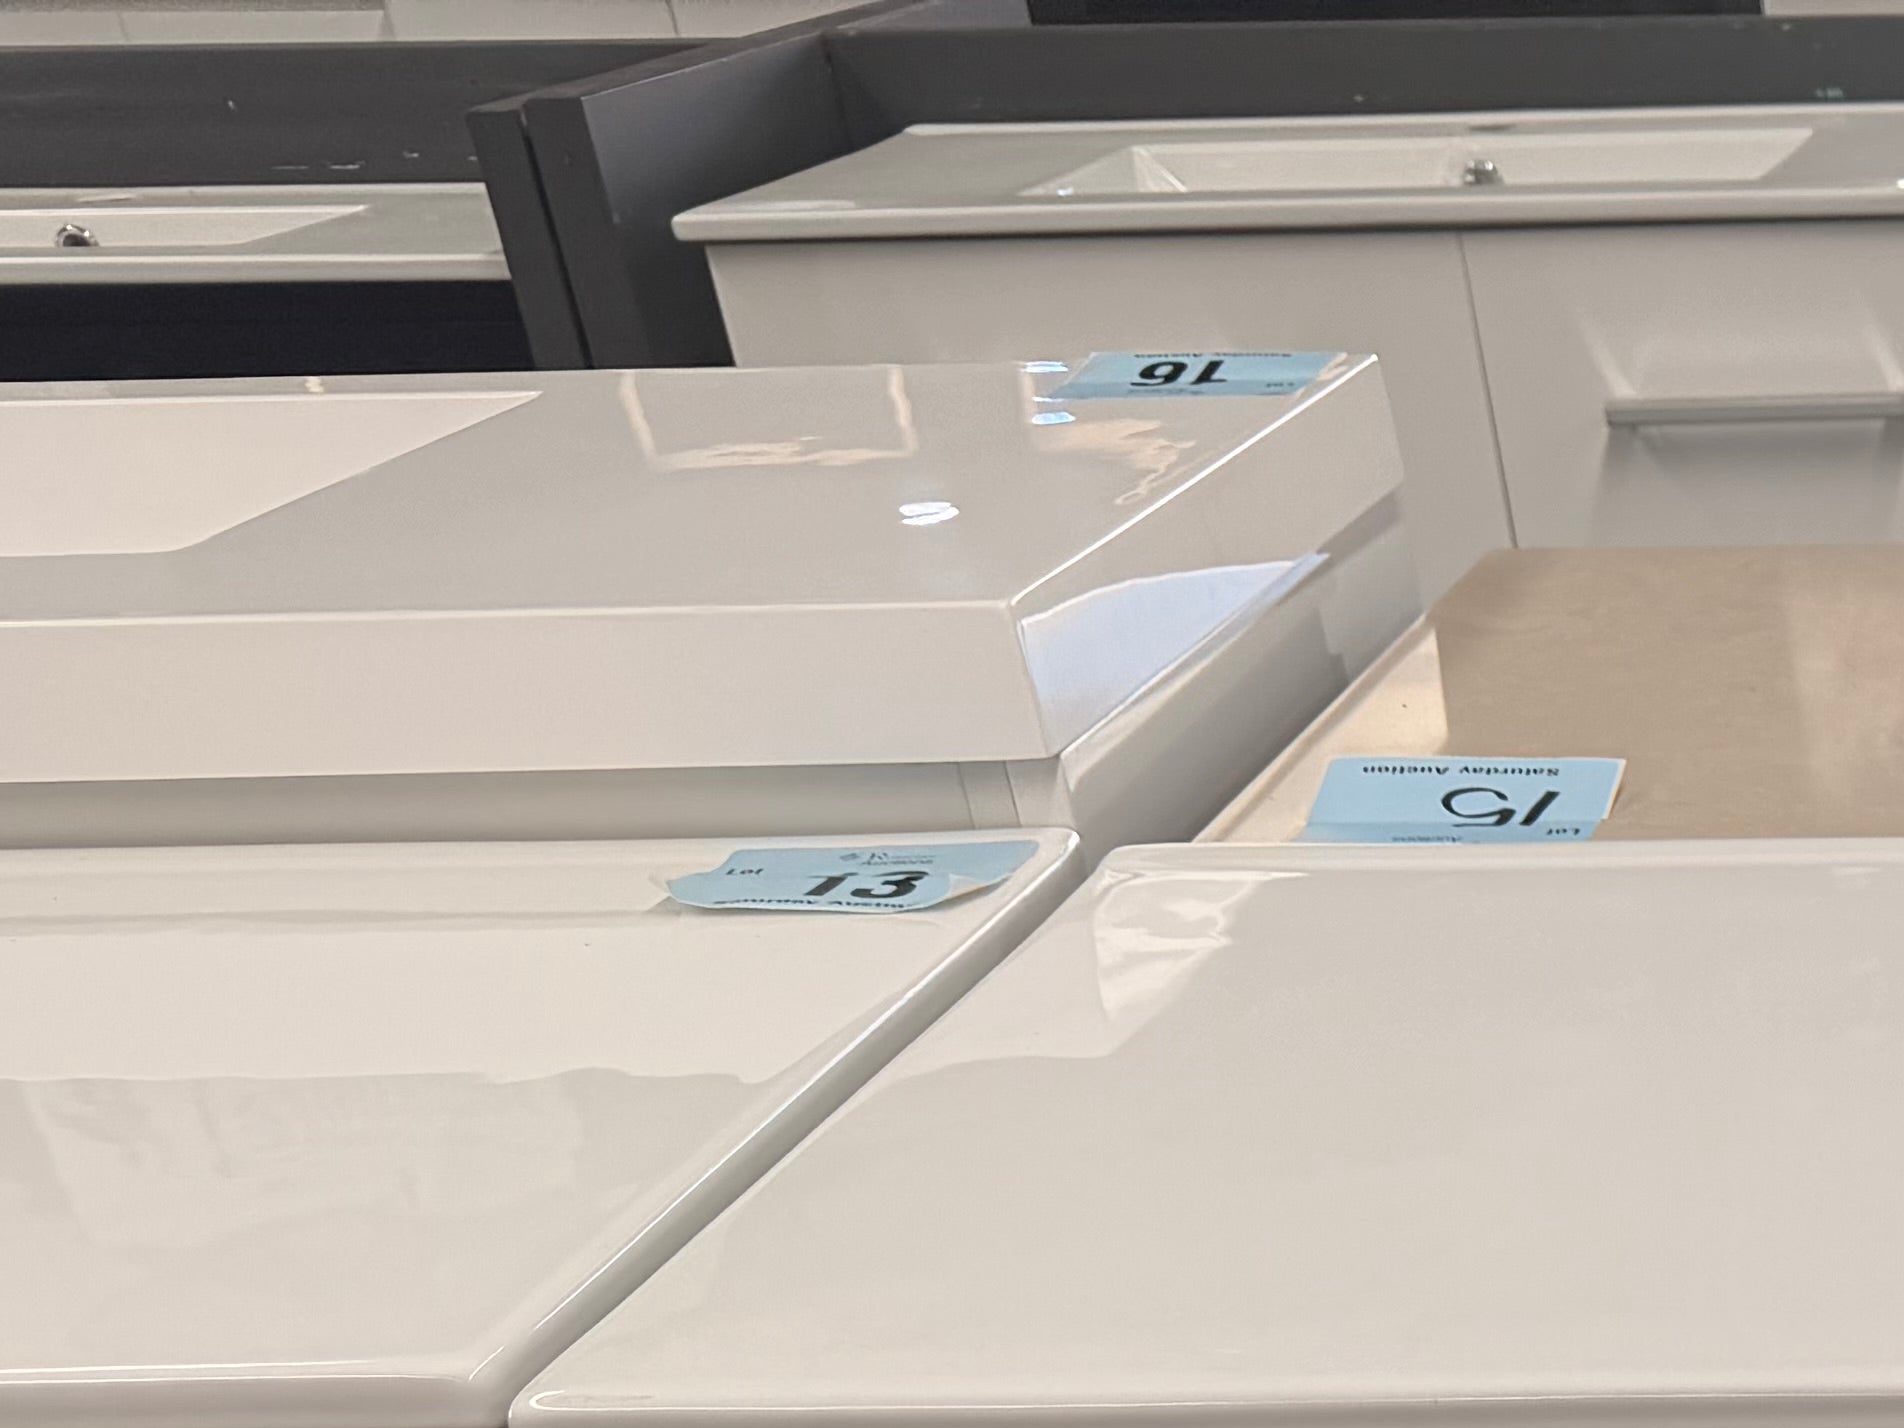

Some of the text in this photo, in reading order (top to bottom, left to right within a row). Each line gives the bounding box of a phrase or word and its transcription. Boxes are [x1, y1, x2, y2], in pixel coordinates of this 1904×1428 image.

[1130, 360, 1229, 387] 16
[1361, 765, 1561, 777] Saturday Auction
[1440, 787, 1561, 827] 15
[724, 867, 766, 876] Lot
[802, 870, 931, 899] 13
